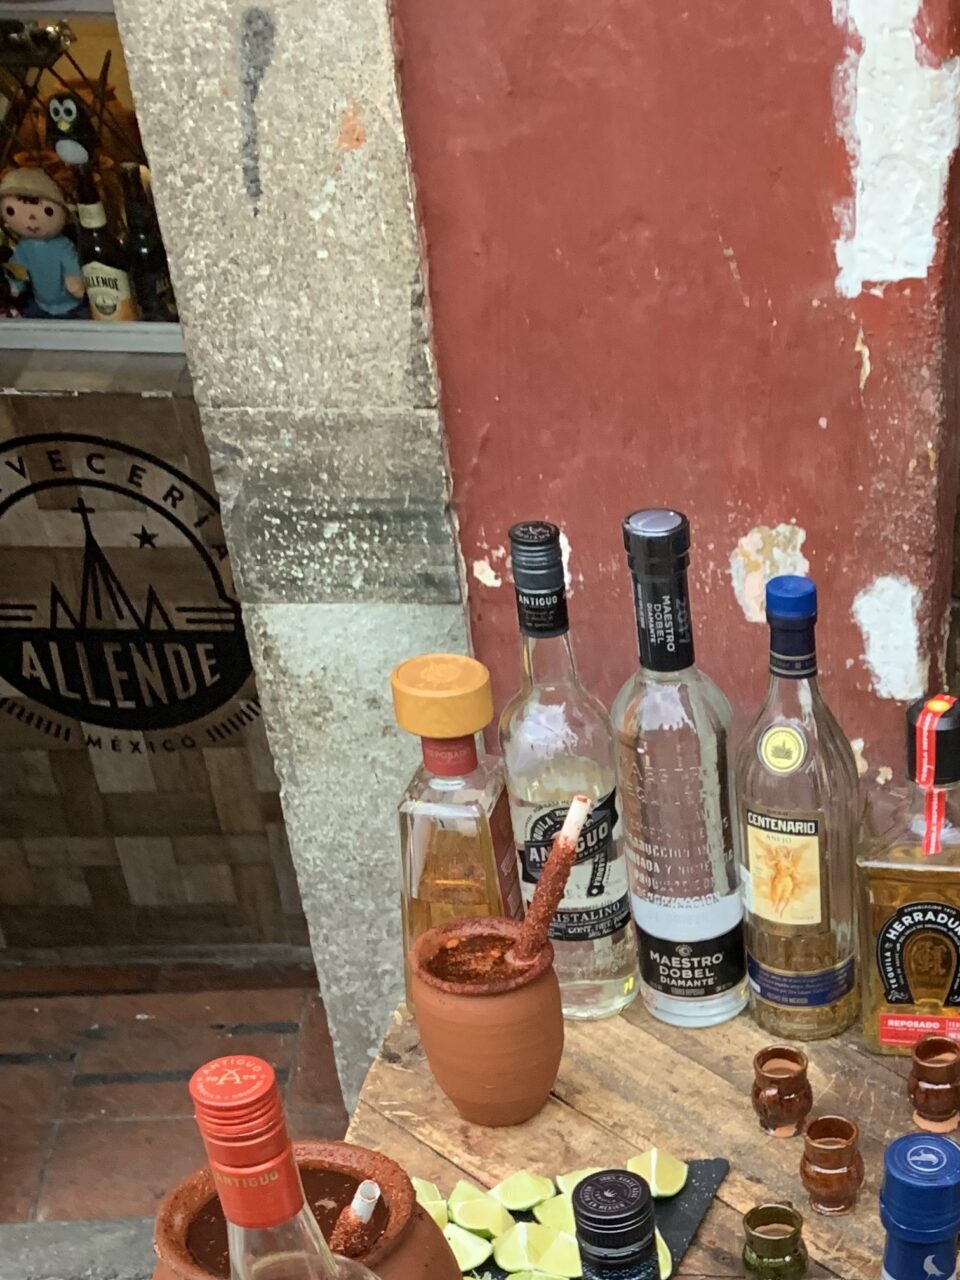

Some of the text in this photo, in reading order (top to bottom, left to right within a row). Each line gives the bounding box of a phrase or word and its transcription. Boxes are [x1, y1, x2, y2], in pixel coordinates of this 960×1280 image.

[518, 594, 558, 606] ANTIGUO
[646, 602, 657, 643] DIAMANTE
[653, 603, 665, 644] DOBEL
[662, 595, 676, 652] MAESTRO
[22, 641, 220, 709] ALLENDE
[532, 816, 554, 841] QUILA
[746, 811, 816, 834] CENTENARIO
[529, 822, 609, 863] ANGUO
[649, 949, 724, 969] MAESTRO
[884, 951, 899, 989] TEQUILA
[659, 965, 715, 979] DOBEL
[660, 976, 715, 987] DIAMANTE
[887, 1019, 940, 1029] REPOSADO
[202, 1058, 262, 1075] ANTIGUO
